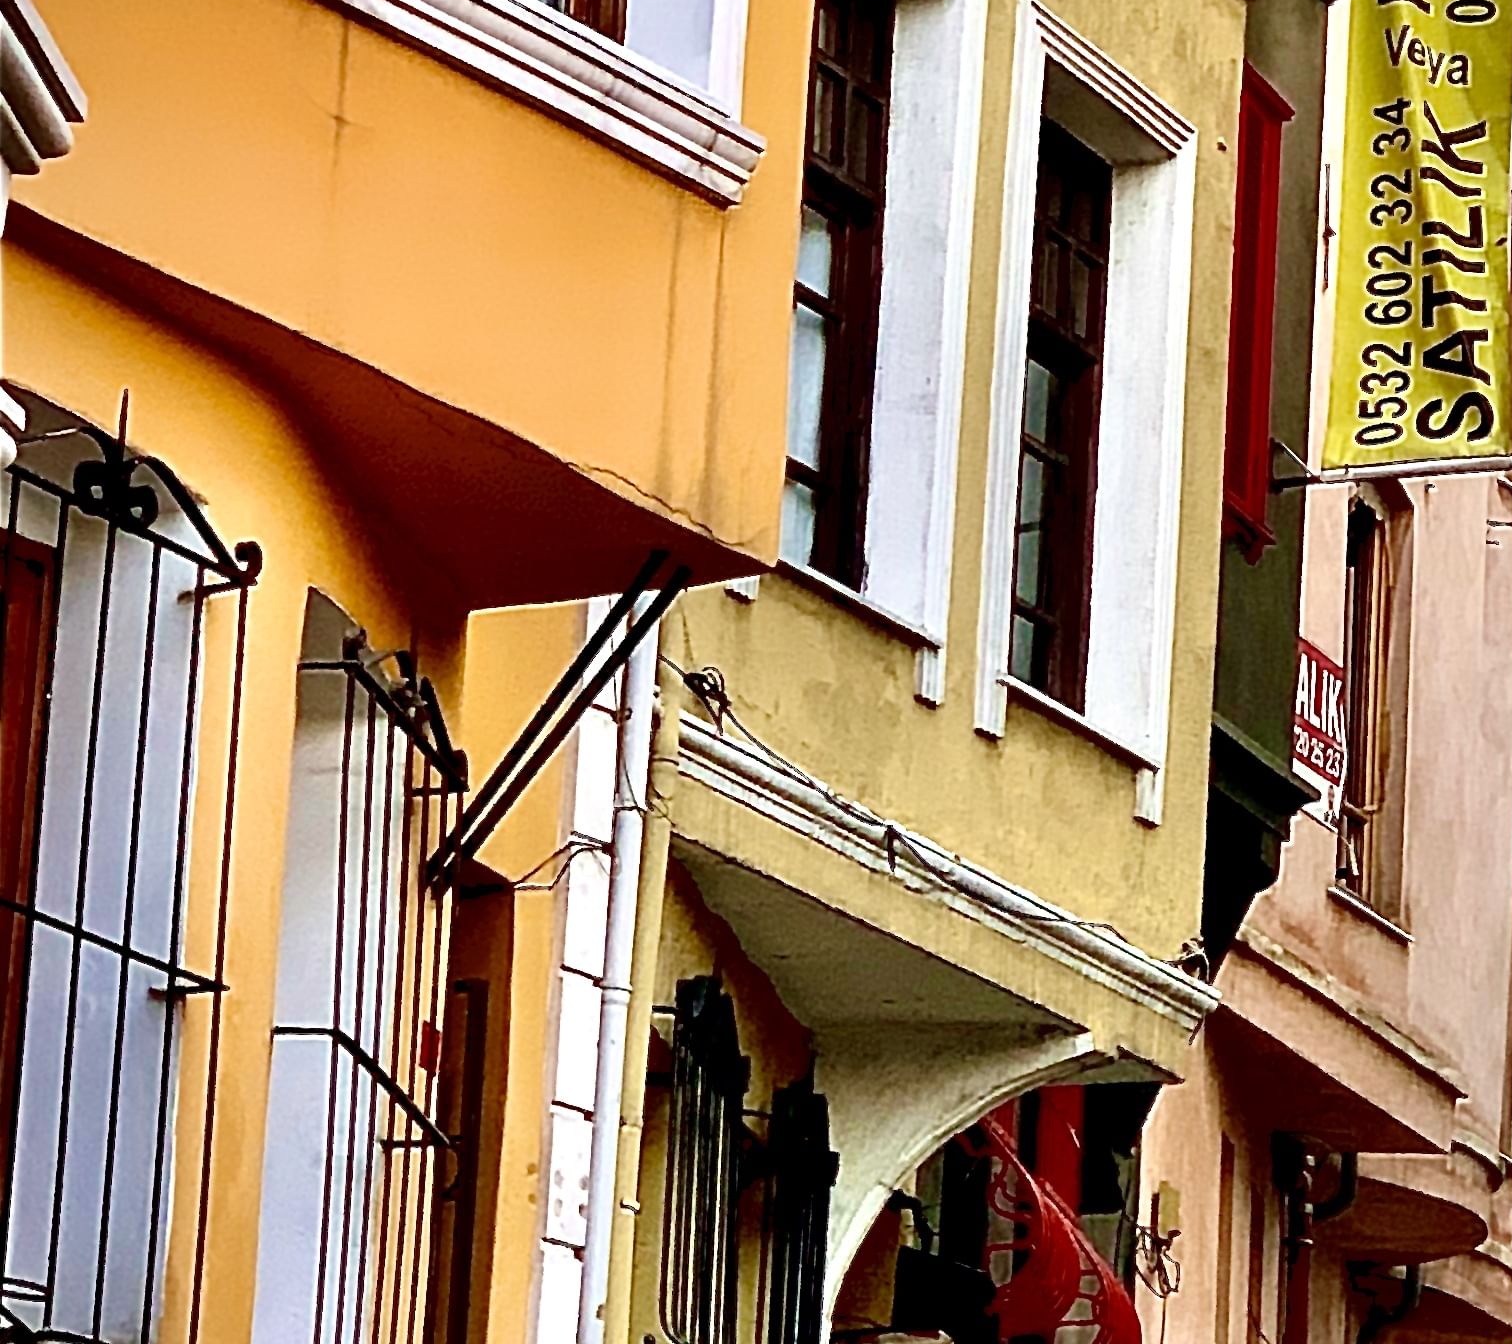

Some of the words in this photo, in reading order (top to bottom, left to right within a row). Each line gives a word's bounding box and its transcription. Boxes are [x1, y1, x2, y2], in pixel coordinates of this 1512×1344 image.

[1384, 23, 1470, 86] Veya
[1372, 95, 1413, 155] 34
[1368, 167, 1414, 228] 32
[1364, 238, 1414, 327] 602
[1416, 99, 1496, 443] SATILIK
[1354, 340, 1414, 447] 0532
